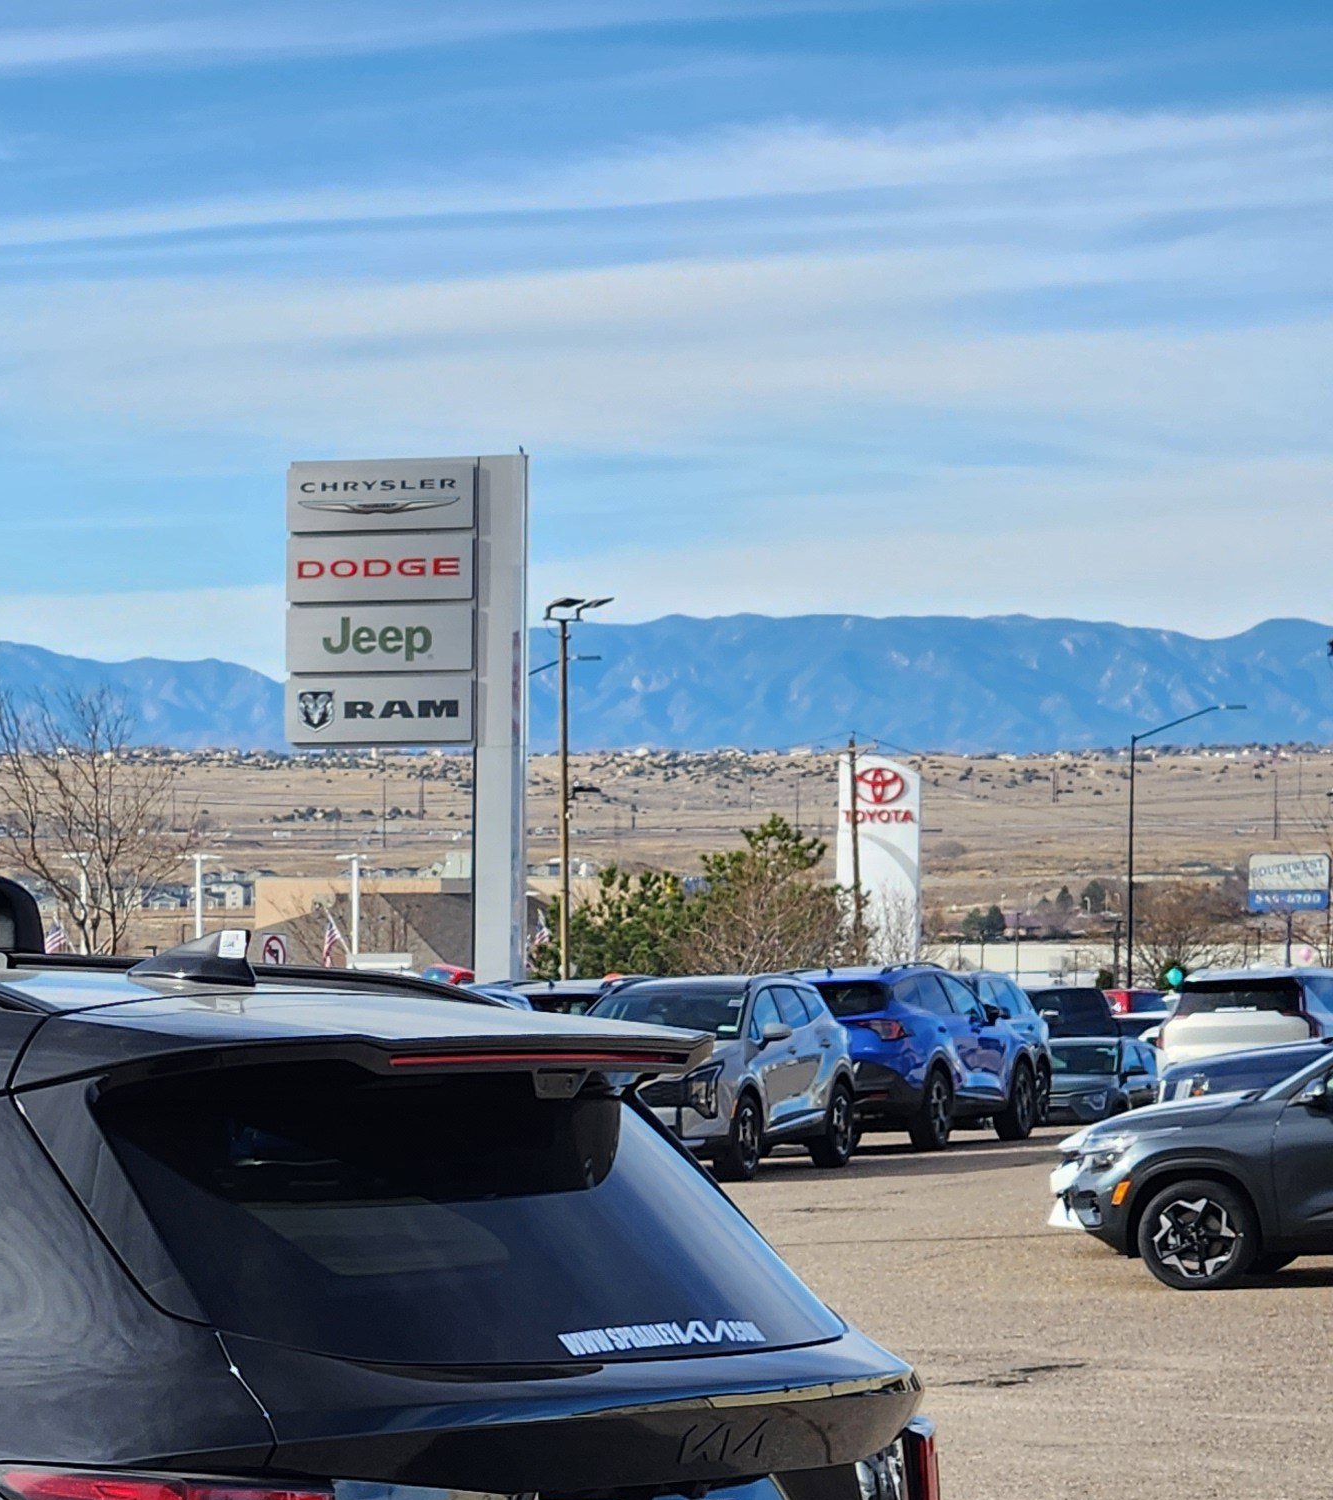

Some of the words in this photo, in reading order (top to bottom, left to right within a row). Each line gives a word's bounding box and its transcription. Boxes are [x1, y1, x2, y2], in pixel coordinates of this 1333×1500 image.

[300, 478, 457, 493] CHRYSLER
[297, 557, 460, 579] DODGE
[322, 616, 432, 662] Jeep
[343, 699, 459, 719] RAM
[842, 809, 915, 824] TOYOTA
